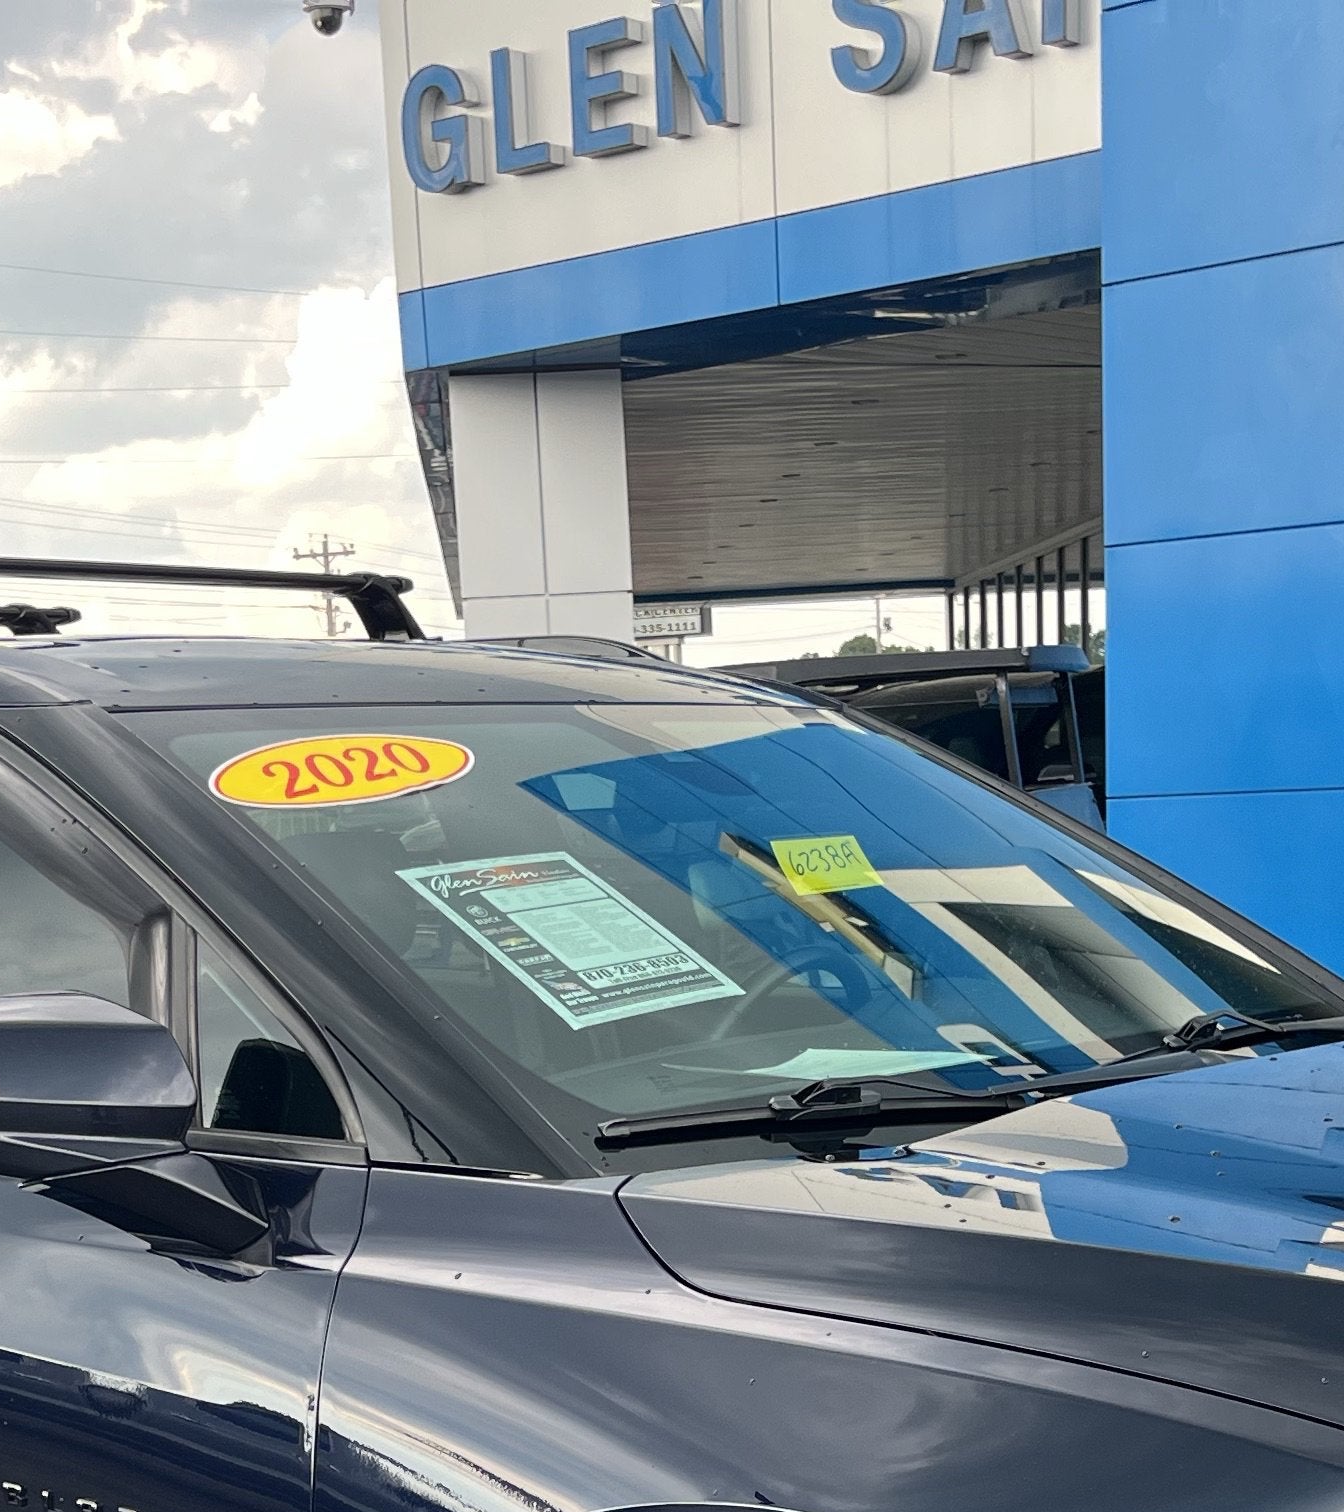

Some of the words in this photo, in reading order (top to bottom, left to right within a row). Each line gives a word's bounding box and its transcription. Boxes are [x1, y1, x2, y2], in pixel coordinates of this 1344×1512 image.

[401, 0, 741, 194] GLEN
[261, 742, 430, 799] 2020
[788, 840, 862, 876] 6238A
[430, 874, 482, 898] Glen
[476, 868, 539, 885] Sain
[474, 916, 503, 926] BUICK
[582, 954, 689, 982] 870-236-8503
